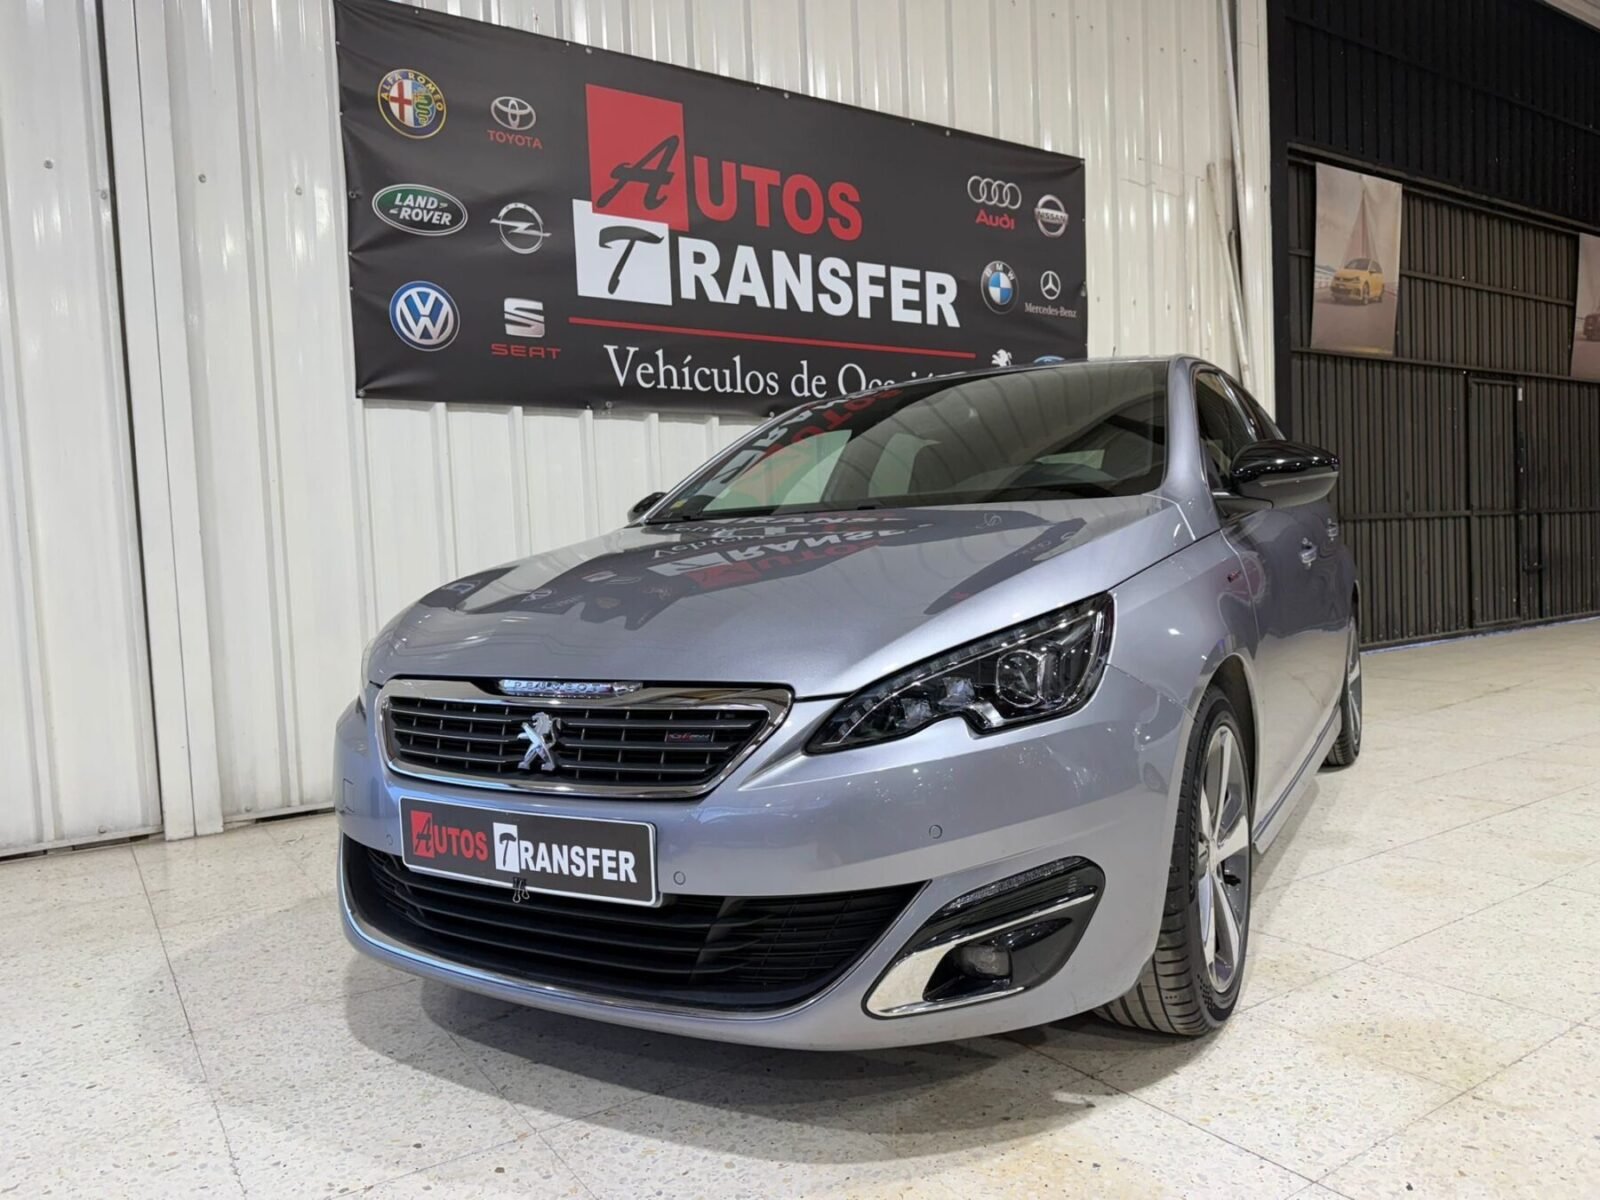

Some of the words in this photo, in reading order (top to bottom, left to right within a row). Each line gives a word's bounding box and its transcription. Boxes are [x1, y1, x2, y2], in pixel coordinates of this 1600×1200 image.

[380, 71, 403, 101] ALFA
[408, 72, 444, 112] ROMEO
[487, 129, 543, 149] TOYOTA
[596, 134, 863, 241] AUTOS
[394, 192, 439, 209] LAND
[399, 206, 453, 226] ROVER
[975, 208, 1016, 230] Audi
[598, 225, 961, 329] TRANSFER
[984, 262, 1015, 282] BMW
[1024, 301, 1078, 318] Mercedes-Benz
[491, 343, 561, 360] SEAT
[603, 344, 780, 396] Vehículos
[790, 360, 828, 399] de
[412, 815, 489, 862] AUTOS
[497, 829, 638, 884] TRANSFER
